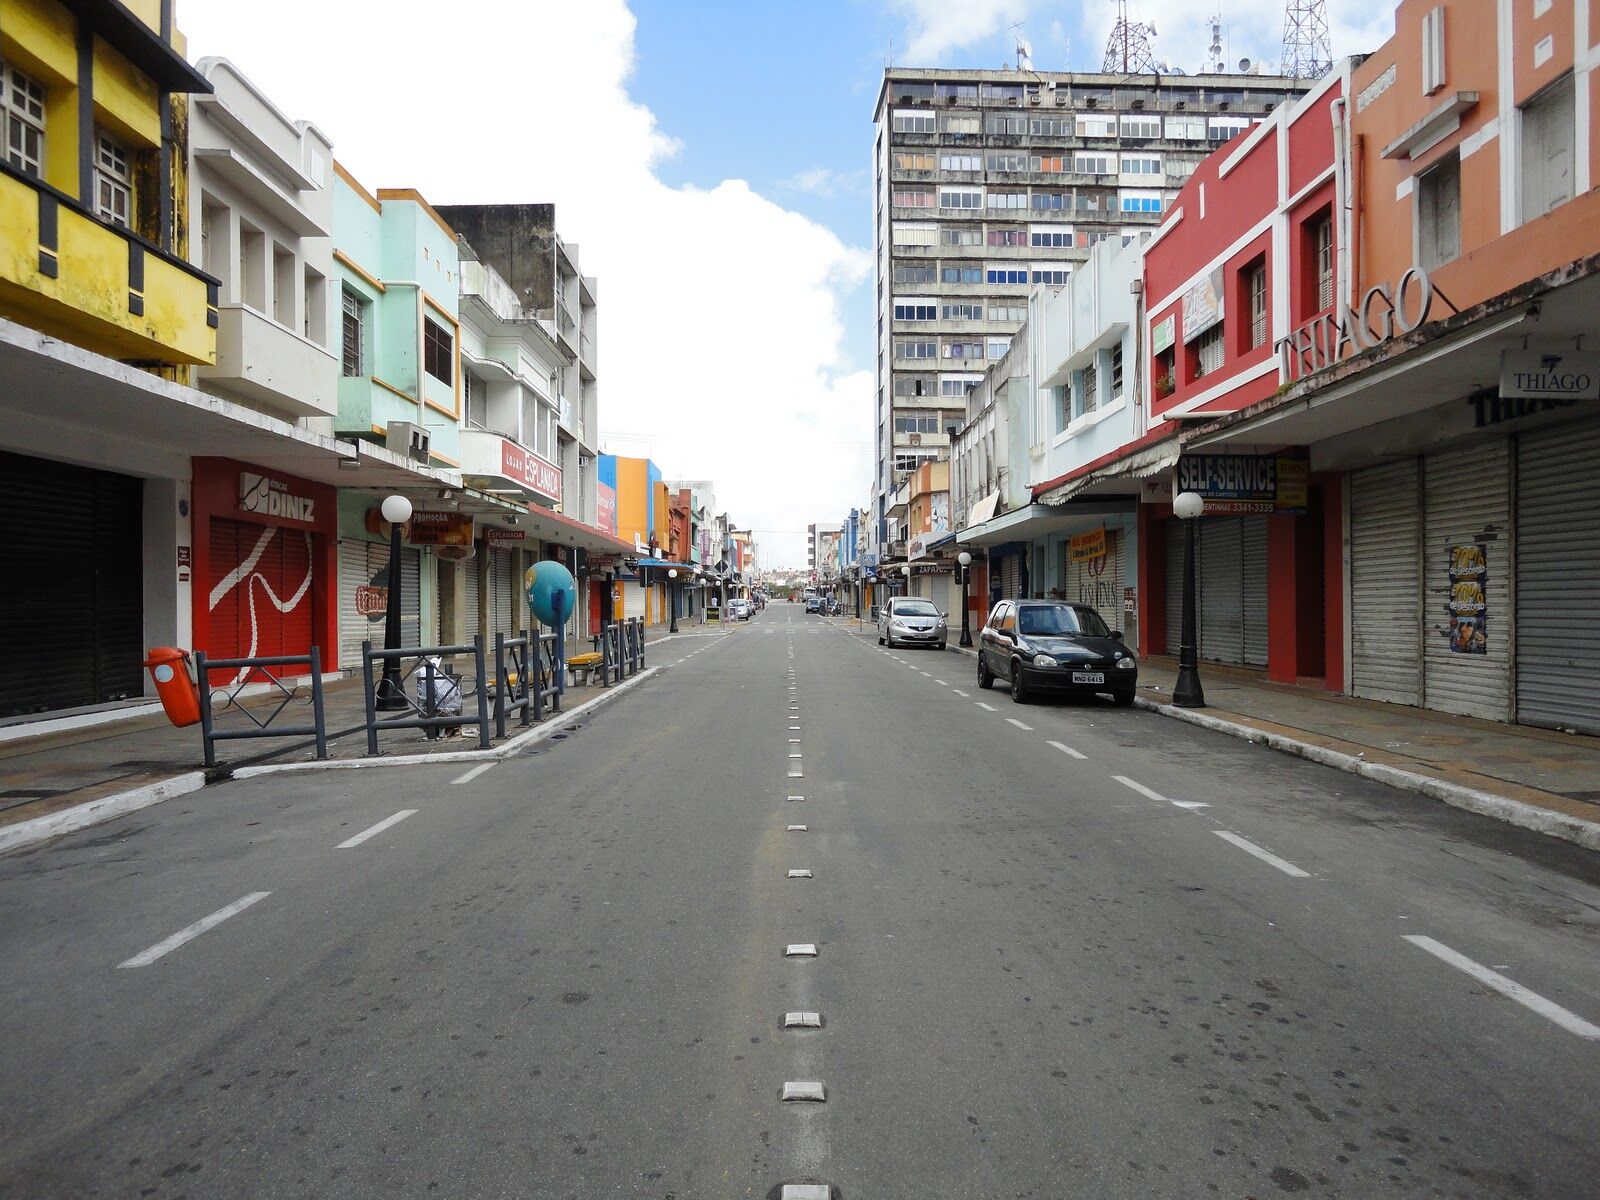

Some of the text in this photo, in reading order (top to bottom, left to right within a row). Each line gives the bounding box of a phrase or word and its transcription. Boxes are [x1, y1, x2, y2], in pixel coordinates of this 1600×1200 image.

[1274, 266, 1432, 386] THIAGO
[1513, 373, 1591, 390] THIAGO
[525, 453, 559, 497] ESPLANADA
[1180, 457, 1275, 491] SELF-SERVICE
[269, 490, 315, 522] DINIZ
[1204, 502, 1274, 513] ENTINHAS 3341-3335
[487, 529, 523, 539] ESPLANADA
